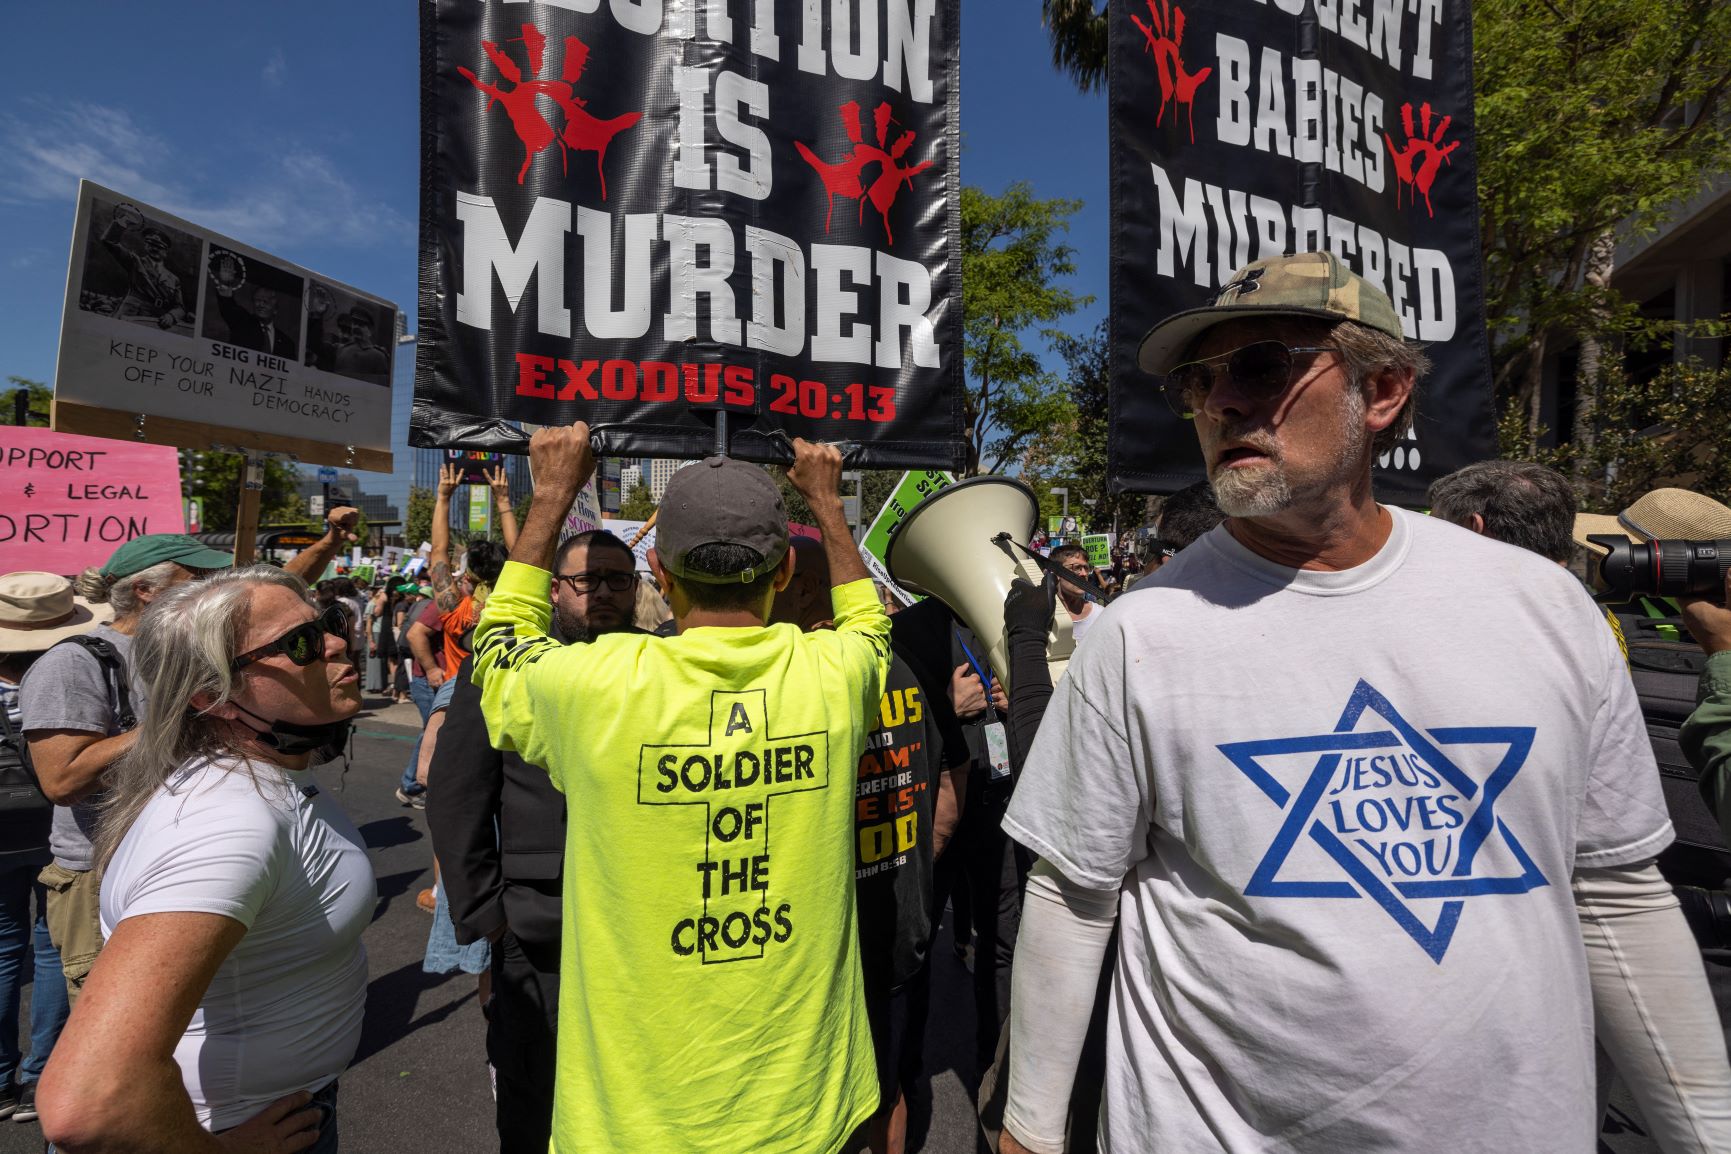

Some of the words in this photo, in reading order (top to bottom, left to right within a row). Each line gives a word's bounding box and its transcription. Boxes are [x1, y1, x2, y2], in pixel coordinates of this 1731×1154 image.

[673, 65, 773, 200] IS
[1216, 33, 1384, 193] BABIES
[456, 190, 941, 368] MURDER
[110, 340, 158, 363] KEEP
[168, 352, 214, 377] YOUR
[229, 367, 288, 395] NAZI
[304, 386, 351, 407] HANDS
[211, 343, 249, 363] SEIG
[256, 354, 289, 373] HEIL
[124, 366, 166, 386] OFF
[178, 378, 213, 397] OUR
[252, 392, 355, 423] DEMOCRACY
[515, 353, 755, 406] EXODUS
[769, 374, 897, 422] 20:13
[0, 448, 107, 471] PPORT
[24, 482, 36, 498] &
[67, 484, 148, 499] LEGAL
[889, 499, 908, 519] fro
[0, 514, 147, 542] ORTION
[725, 702, 752, 736] A
[865, 731, 893, 750] AID
[656, 744, 815, 793] SOLDIER
[856, 771, 912, 797] EREFORE
[1329, 753, 1441, 795] JESUS
[712, 803, 763, 842] OF
[1328, 794, 1464, 833] LOVES
[859, 811, 918, 864] OD
[1353, 834, 1452, 877] YOU
[697, 854, 770, 899] THE
[855, 866, 878, 880] OHN
[671, 903, 793, 956] CROSS
